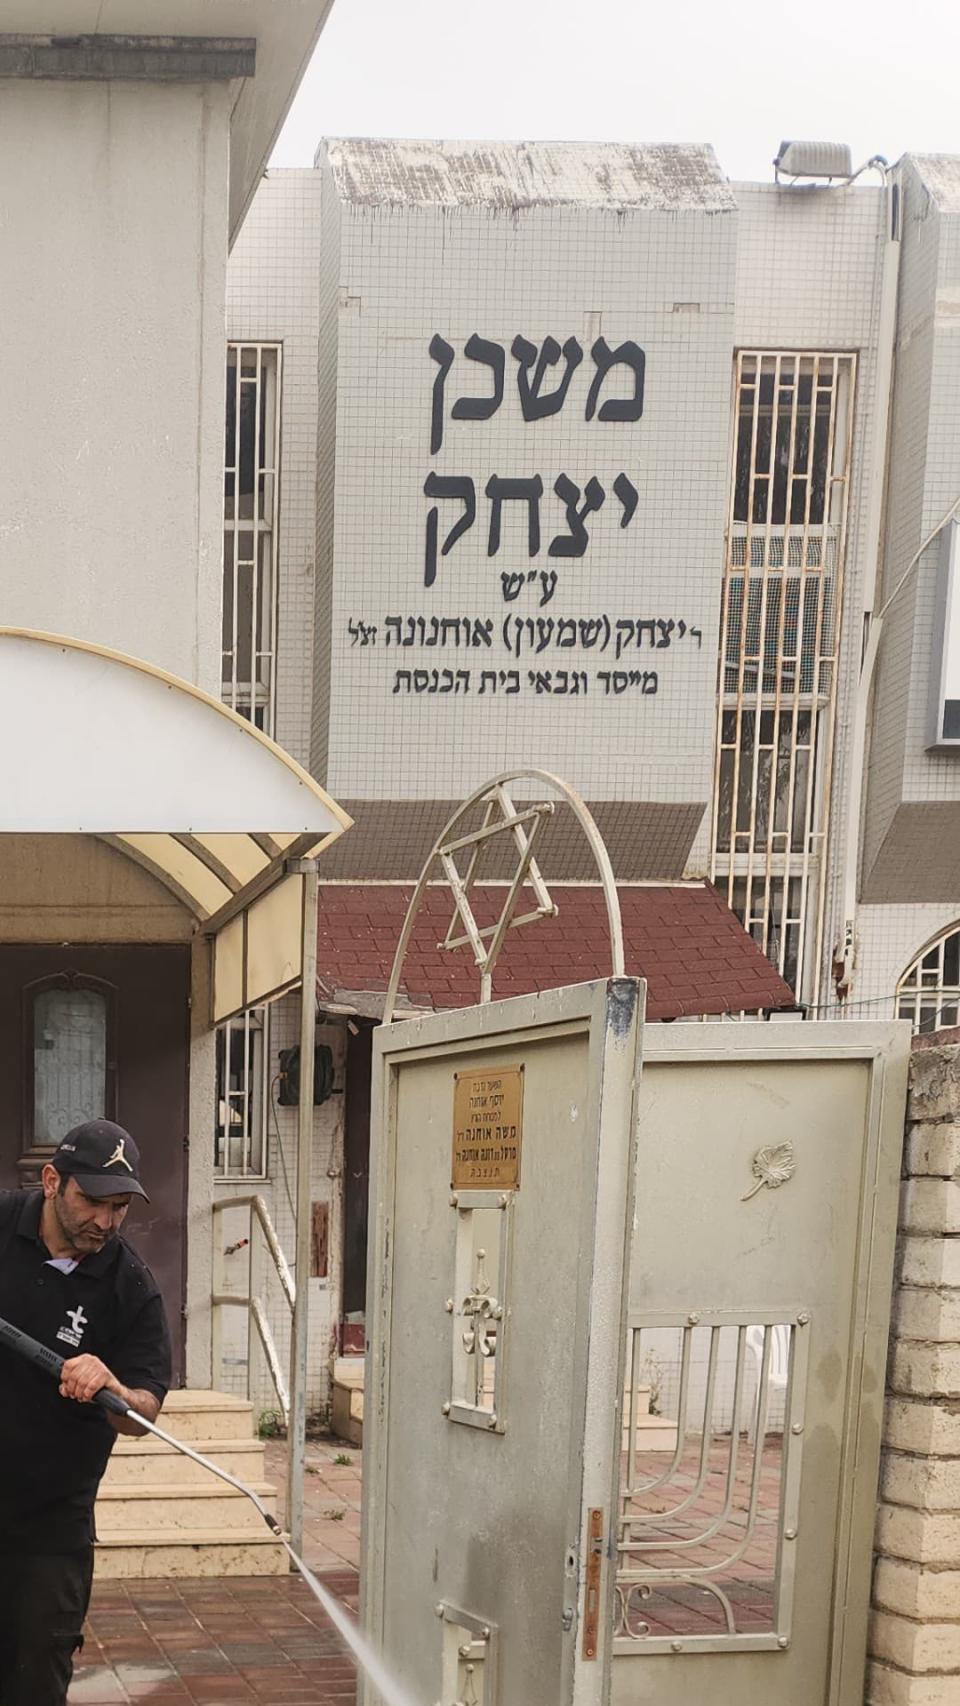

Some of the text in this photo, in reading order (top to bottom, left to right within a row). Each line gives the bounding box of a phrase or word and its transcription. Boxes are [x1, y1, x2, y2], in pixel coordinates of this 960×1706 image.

[429, 333, 646, 456] משכן
[424, 471, 639, 588] יצחק
[501, 569, 558, 608] ע"ש
[385, 616, 494, 648] אוחנונה
[393, 669, 658, 695] מייסד וגבאי בית הכנסת
[465, 1127, 492, 1141] אוחנה
[495, 1125, 517, 1141] משה
